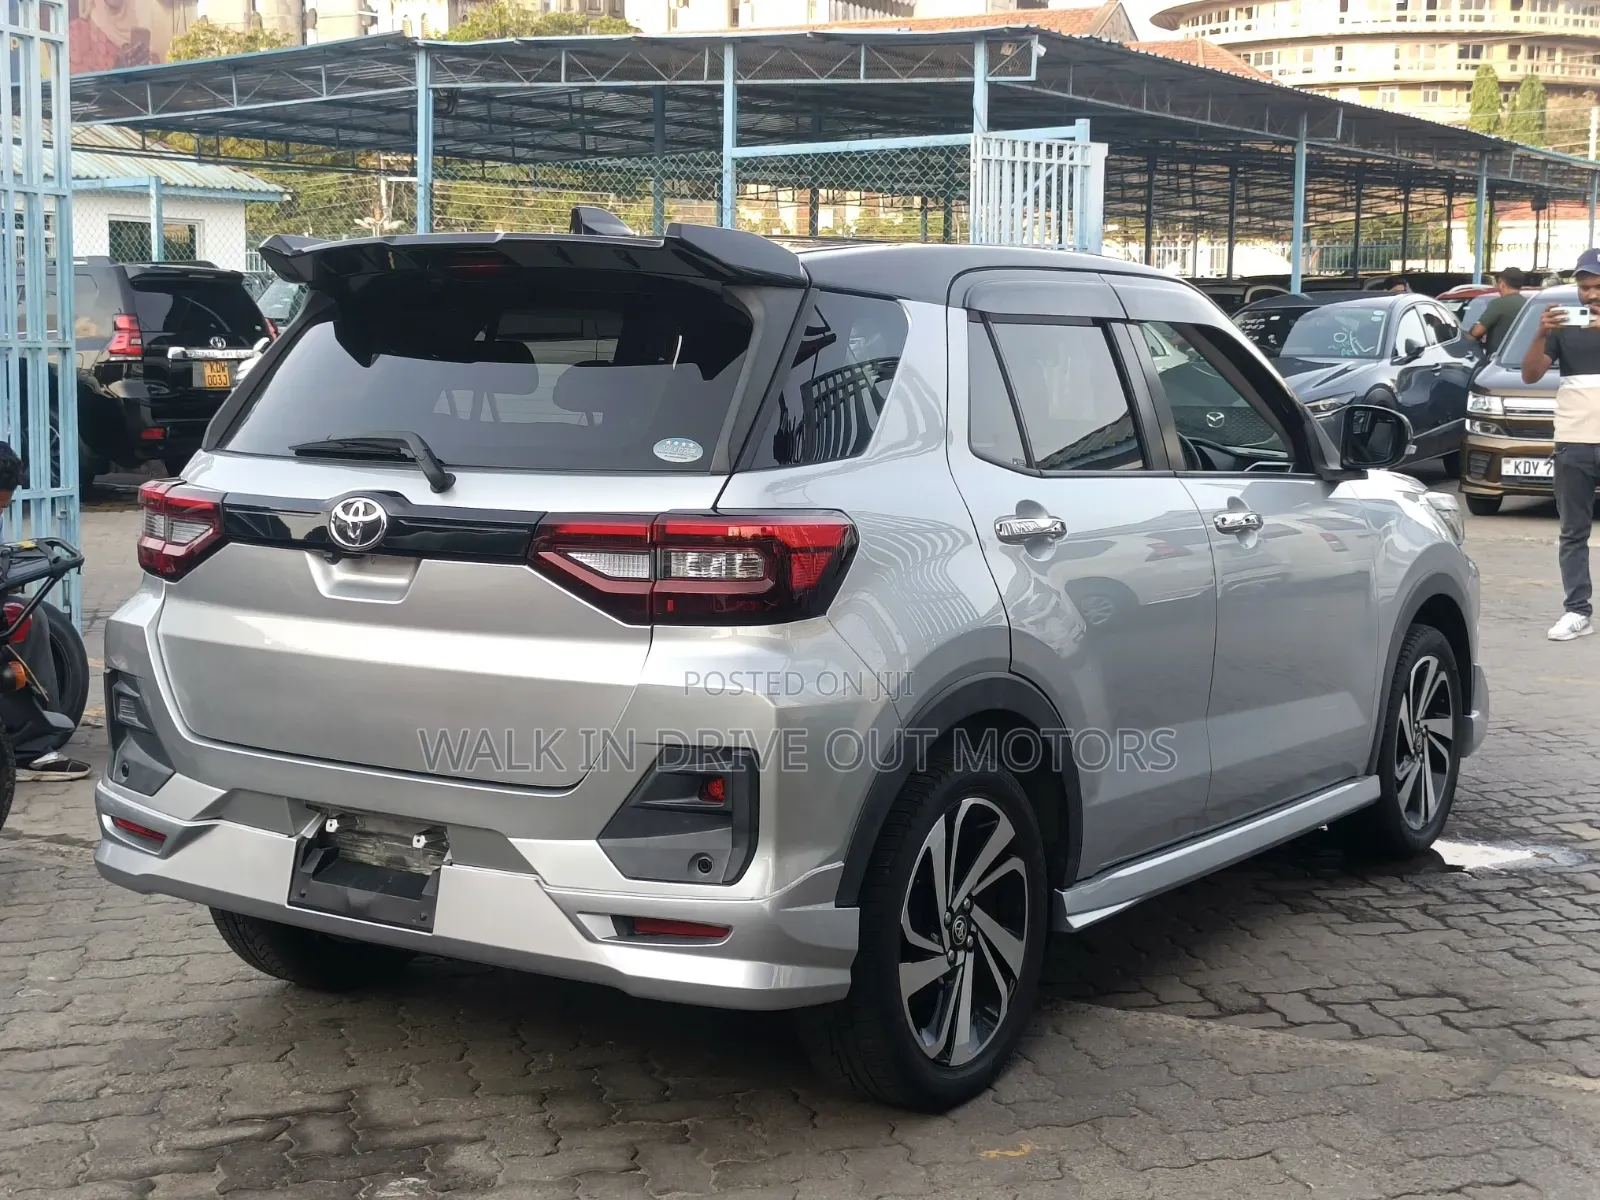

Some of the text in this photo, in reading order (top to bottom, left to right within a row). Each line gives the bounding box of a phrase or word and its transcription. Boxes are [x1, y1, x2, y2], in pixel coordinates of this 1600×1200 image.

[209, 360, 227, 373] KDW
[207, 374, 228, 386] 003J
[1514, 461, 1539, 475] KDY
